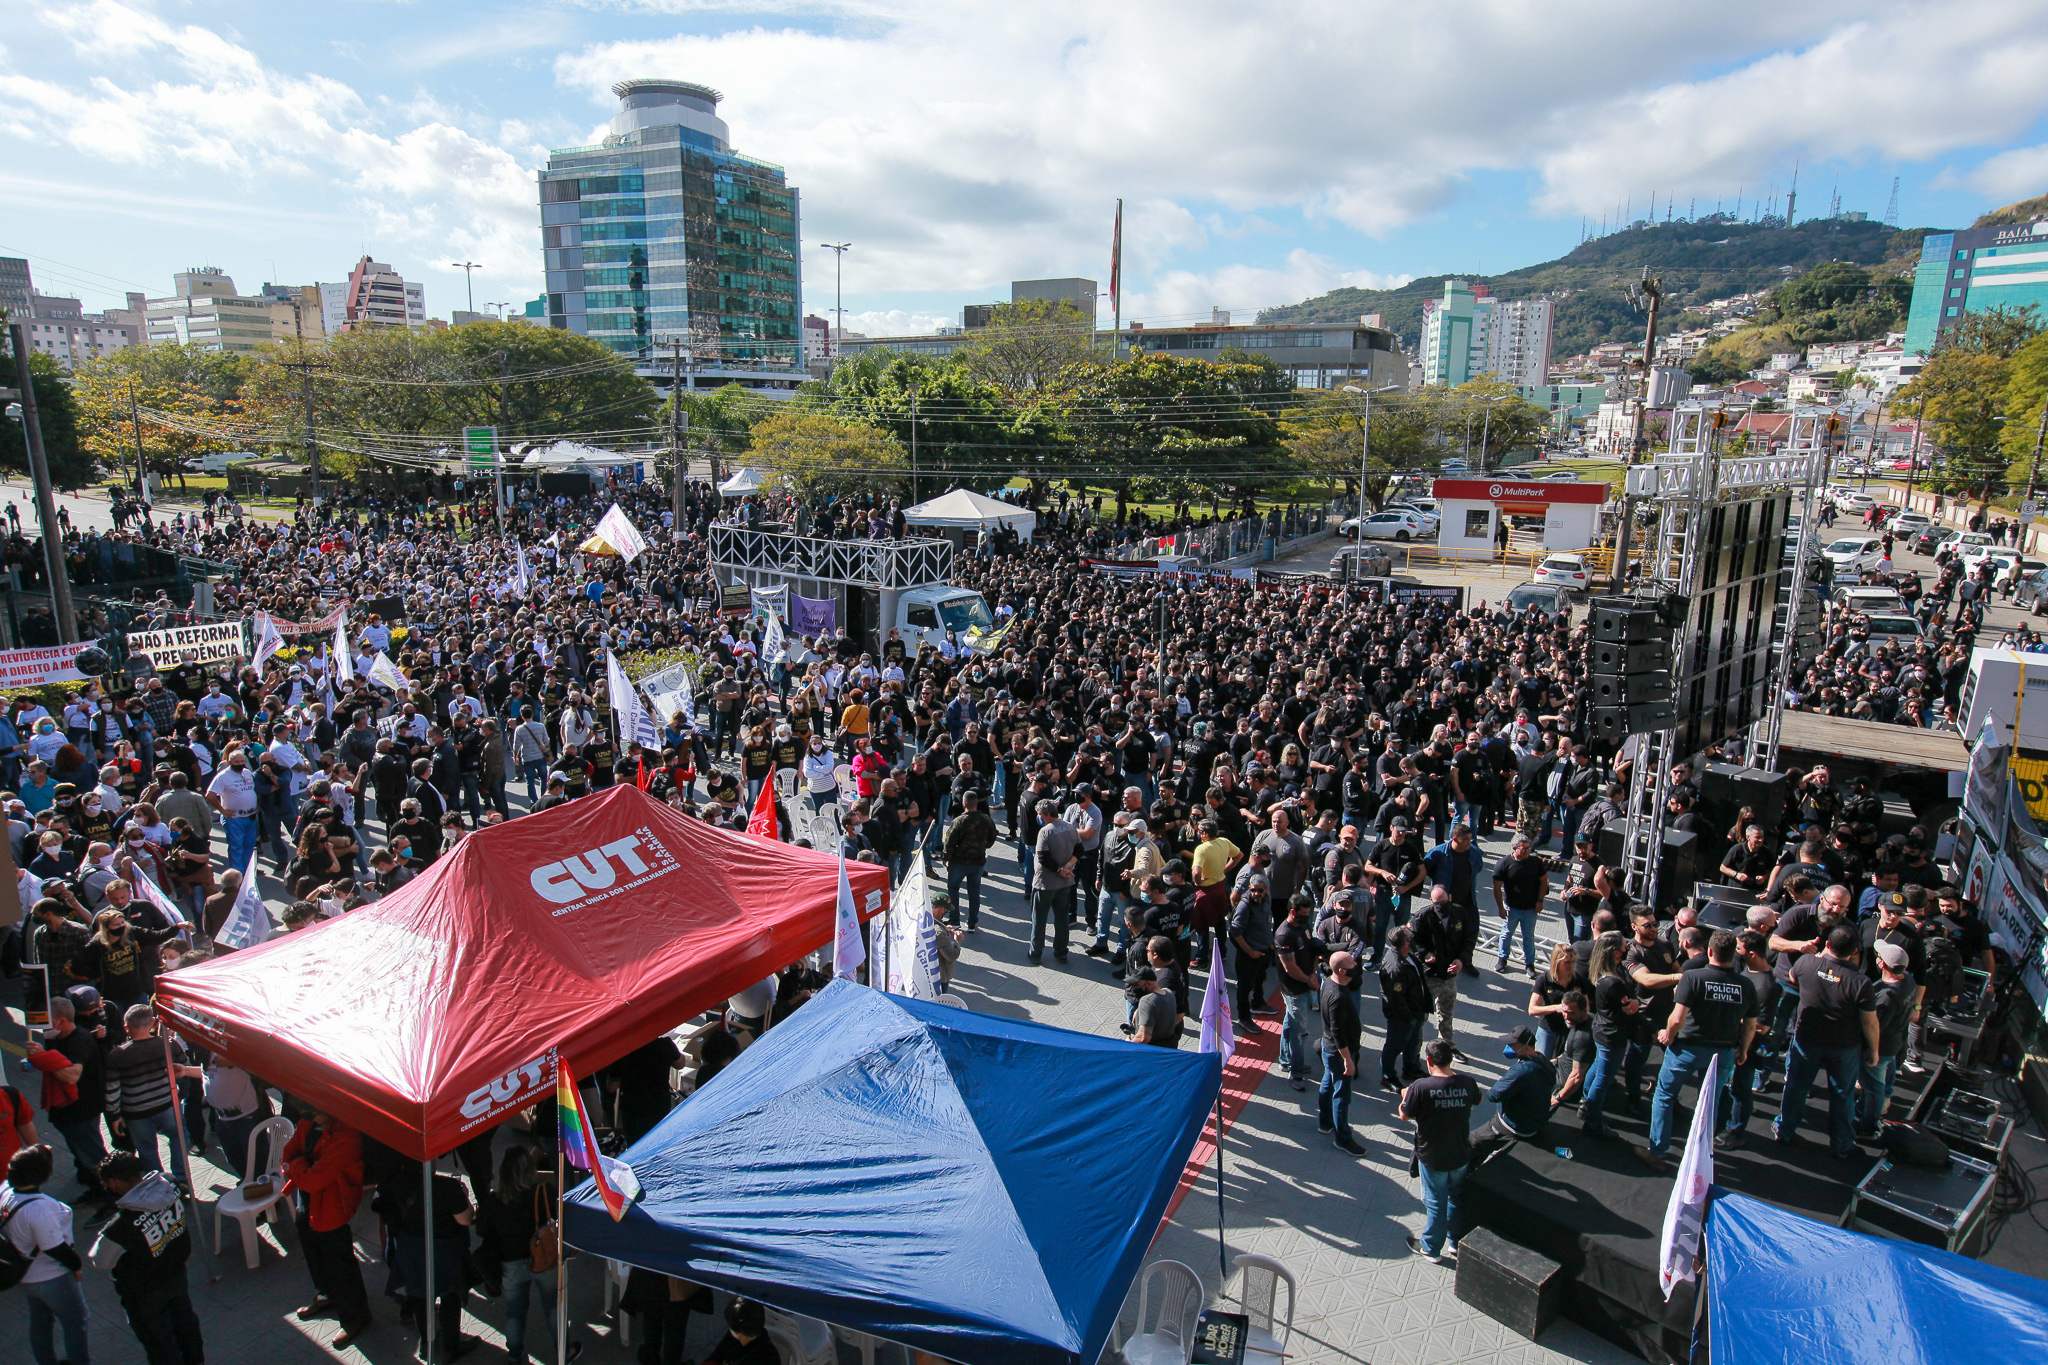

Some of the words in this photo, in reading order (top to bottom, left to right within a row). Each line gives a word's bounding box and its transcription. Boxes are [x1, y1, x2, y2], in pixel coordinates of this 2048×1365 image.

[1998, 227, 2030, 239] BAÍA
[1960, 492, 1967, 500] E
[1317, 581, 1379, 593] DIRETOS
[175, 624, 240, 645] REFORMA
[0, 649, 61, 664] REVIDÊNCIA
[62, 646, 68, 657] É
[9, 662, 51, 677] DIREITO
[52, 660, 60, 671] À
[10, 679, 22, 687] RIO
[530, 834, 650, 904] CUT
[552, 901, 587, 917] CENTRAL
[585, 893, 610, 905] ÚNICA
[610, 886, 625, 897] DOS
[625, 862, 681, 890] TRABALHADORES
[1707, 983, 1740, 995] POLÍCIA
[1712, 993, 1734, 1002] CIVIL
[460, 1054, 547, 1118] CUT
[1429, 1087, 1468, 1098] POLÍCIA
[1434, 1098, 1466, 1108] PENAL
[461, 1116, 487, 1132] CENTRAL
[486, 1106, 505, 1119] ÚNICA
[505, 1100, 517, 1110] DOS
[1204, 1323, 1219, 1351] LUTAR
